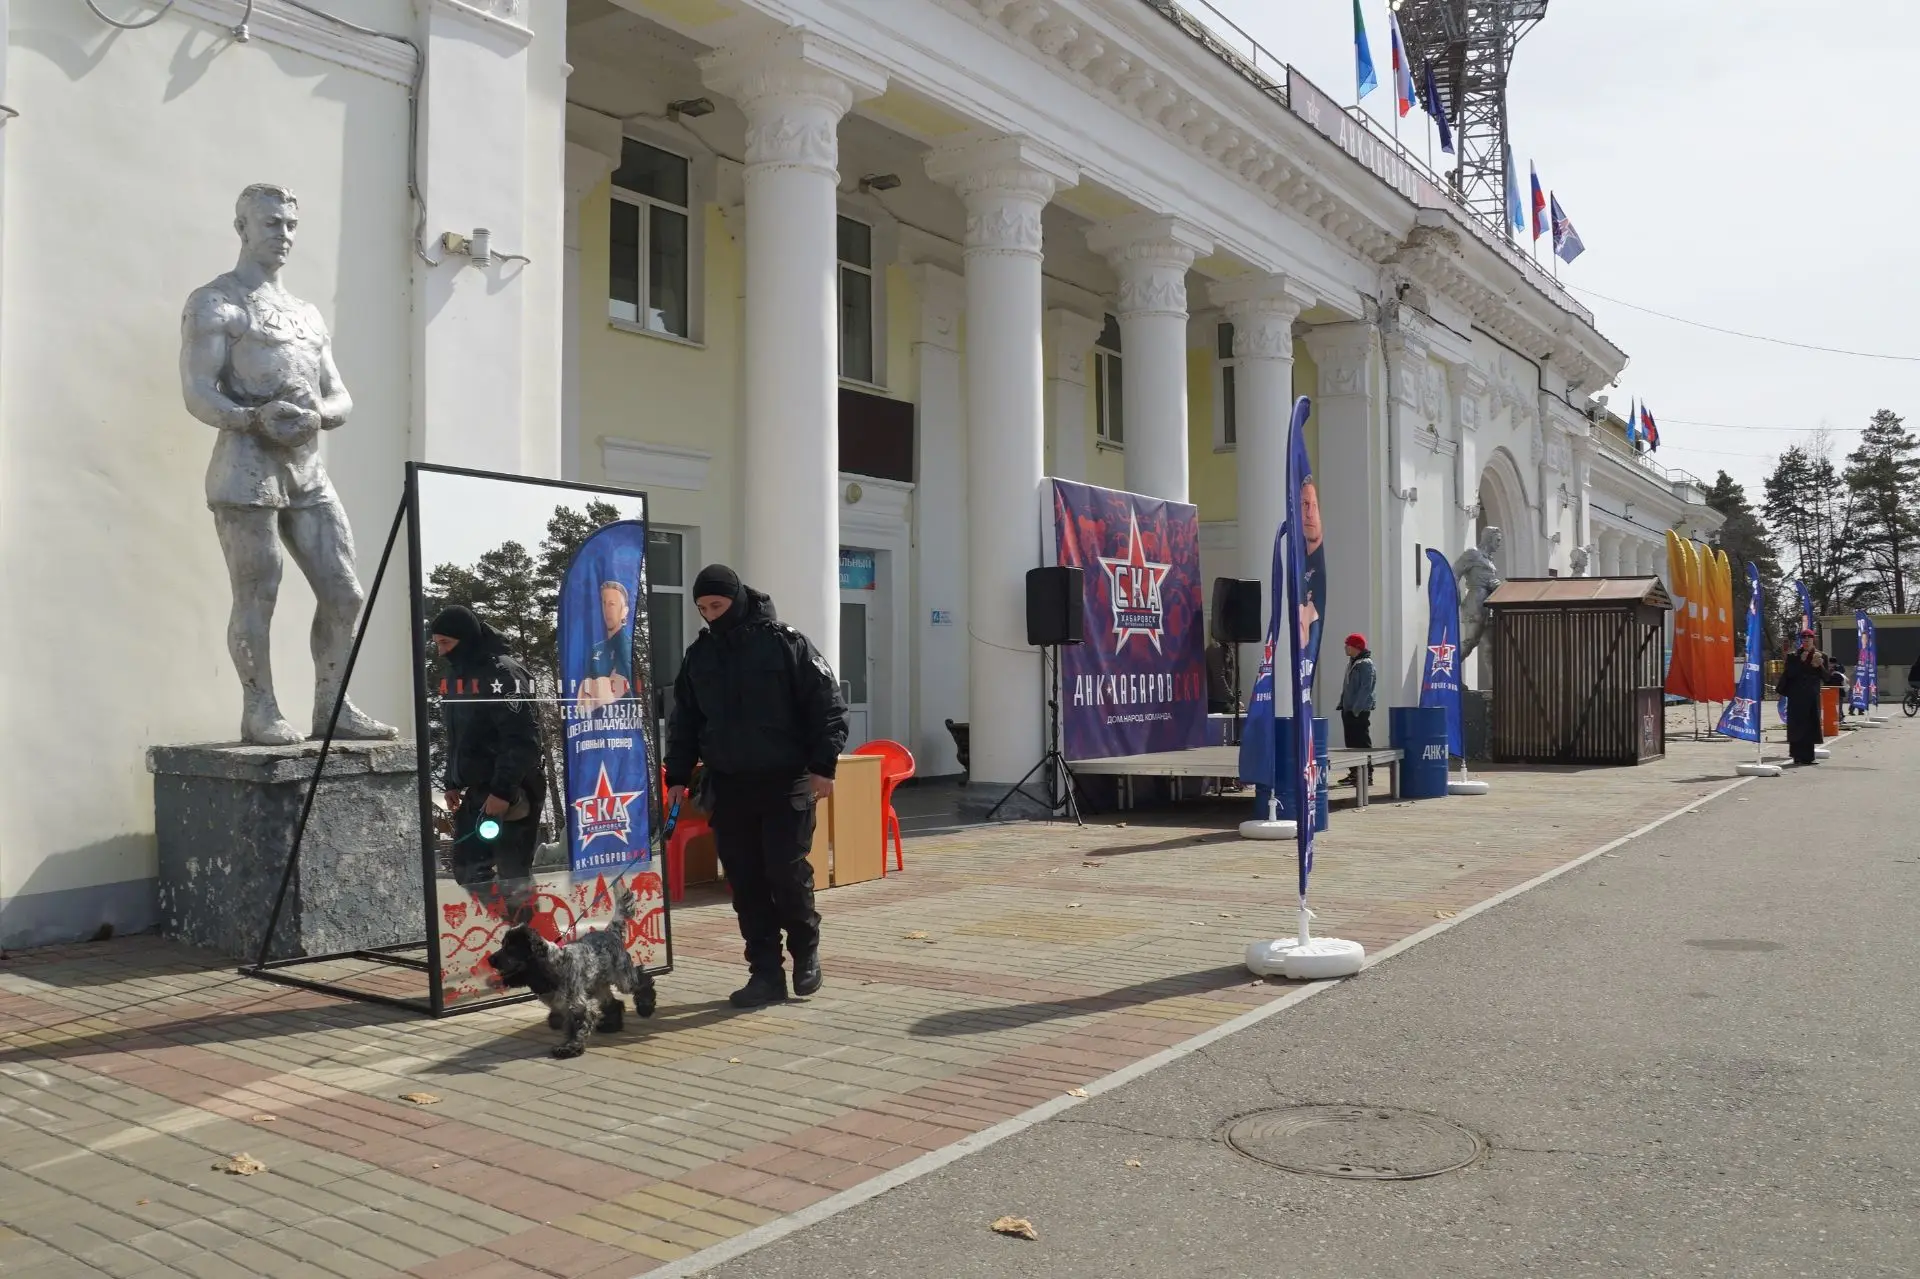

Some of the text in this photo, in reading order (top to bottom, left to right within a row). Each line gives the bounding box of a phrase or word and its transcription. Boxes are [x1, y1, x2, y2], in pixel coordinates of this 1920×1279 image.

[1115, 566, 1160, 610] СКА
[602, 703, 643, 719] 2025/26
[581, 797, 626, 825] СКА
